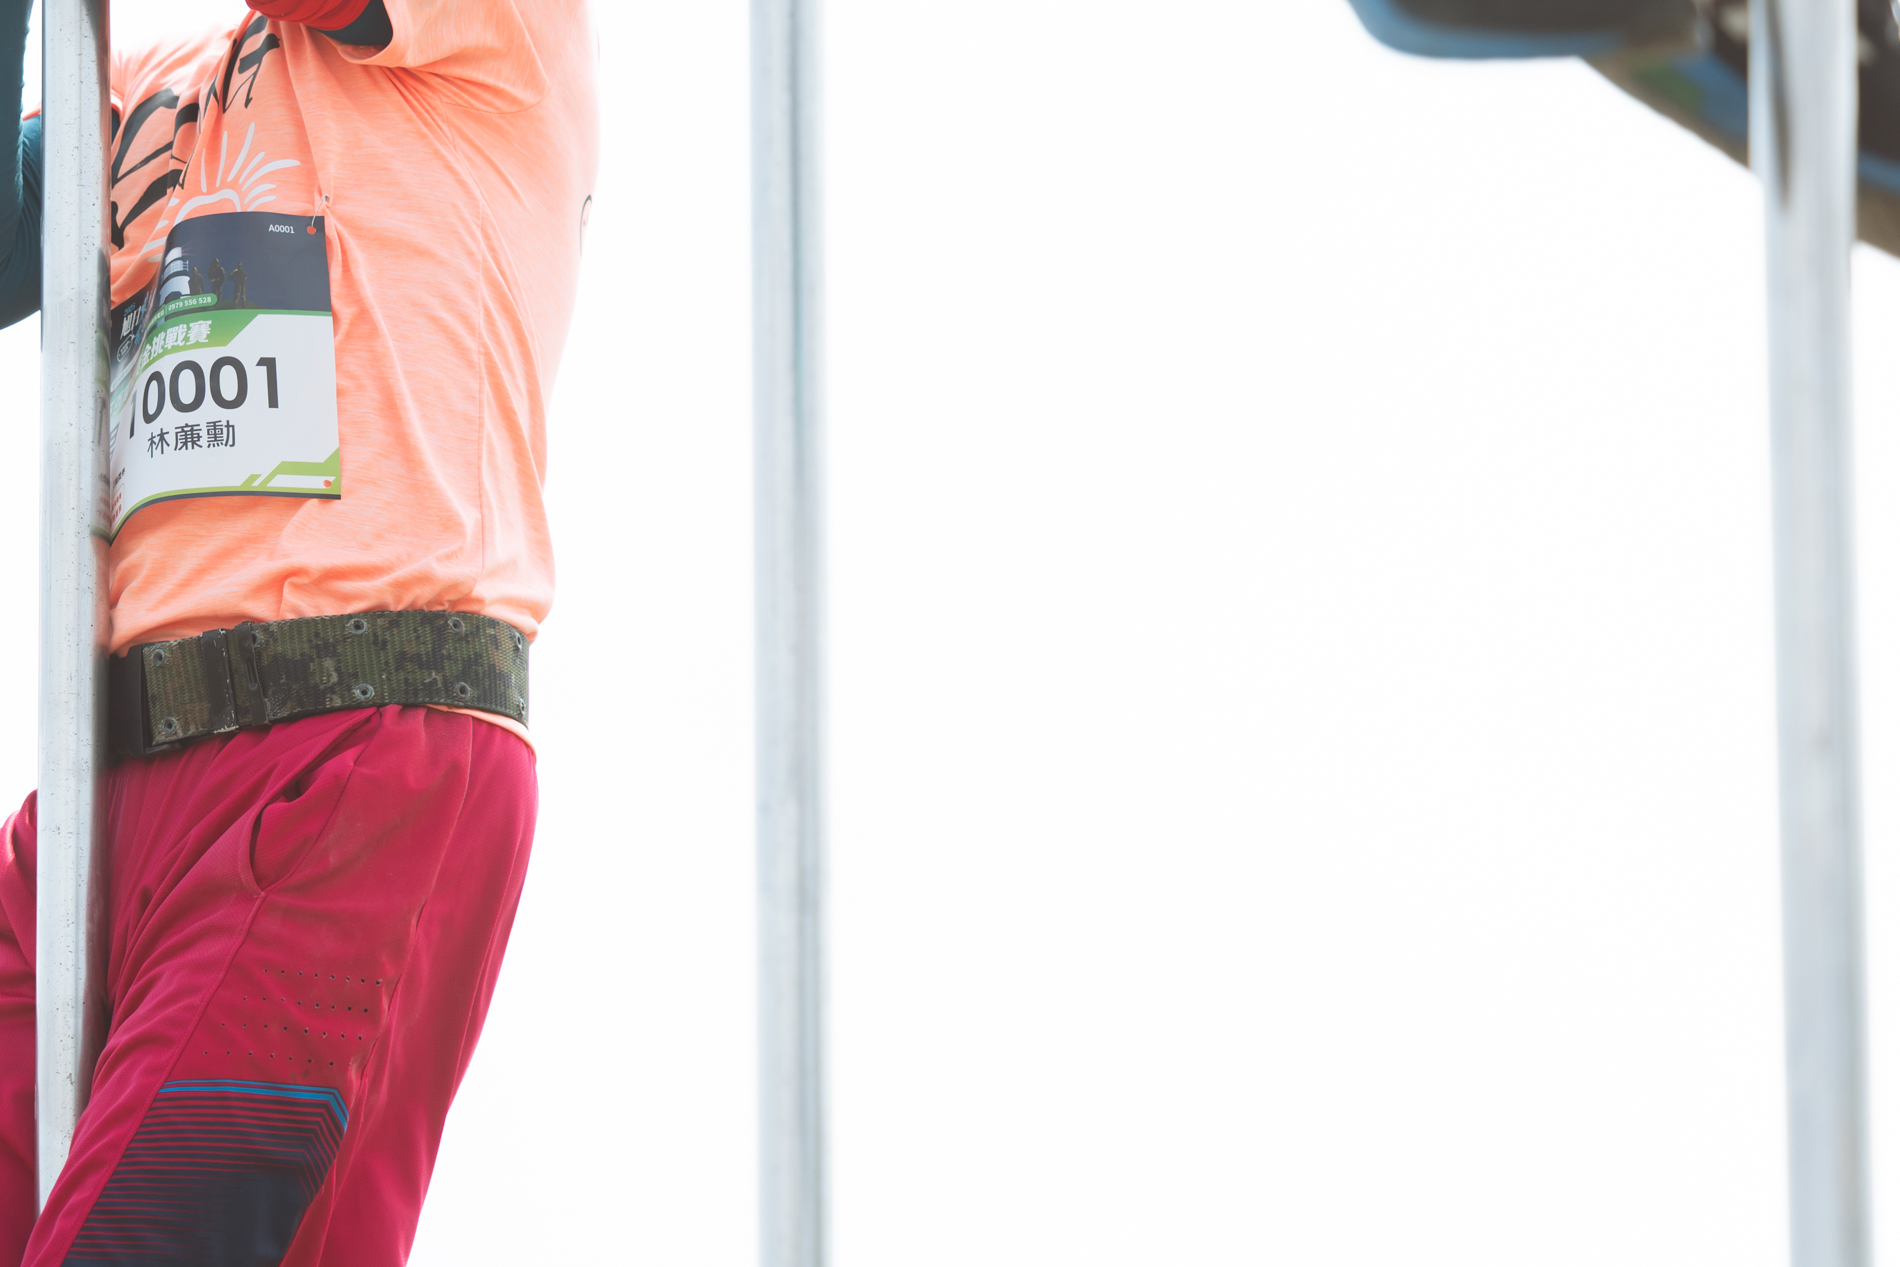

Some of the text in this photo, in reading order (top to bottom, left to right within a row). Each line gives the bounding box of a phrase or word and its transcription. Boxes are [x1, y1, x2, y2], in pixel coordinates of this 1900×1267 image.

[268, 223, 295, 234] A0001
[168, 296, 212, 311] 0979 556 528
